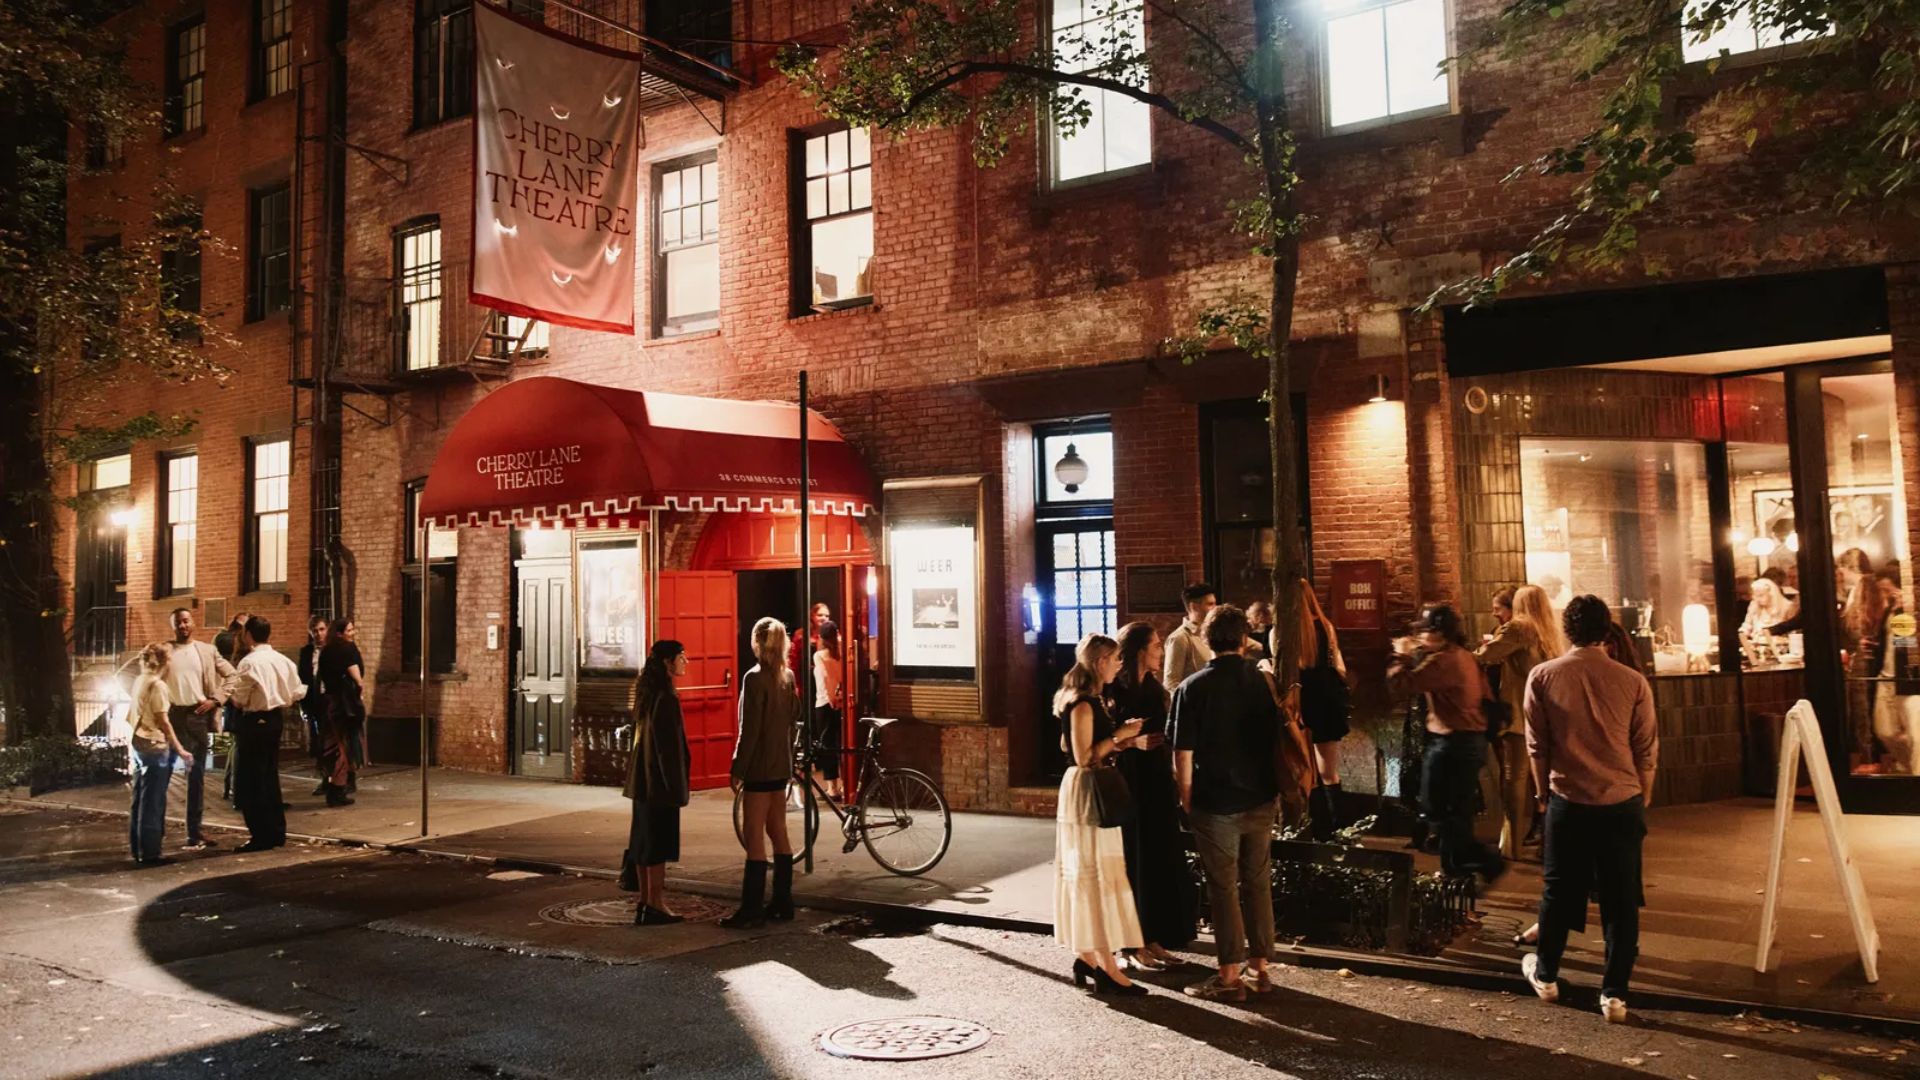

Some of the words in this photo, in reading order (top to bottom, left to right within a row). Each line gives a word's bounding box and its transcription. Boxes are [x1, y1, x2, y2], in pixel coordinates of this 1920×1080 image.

[498, 108, 621, 169] CHERRY
[518, 150, 604, 199] LANE
[486, 171, 631, 235] THEATRE
[476, 450, 536, 474] CHERRY
[539, 445, 581, 466] LANE
[494, 467, 565, 490] THEATRE
[733, 474, 786, 485] COMMERCE
[917, 559, 953, 573] WEER
[1349, 583, 1371, 594] BOX
[1344, 599, 1376, 610] OFFICE
